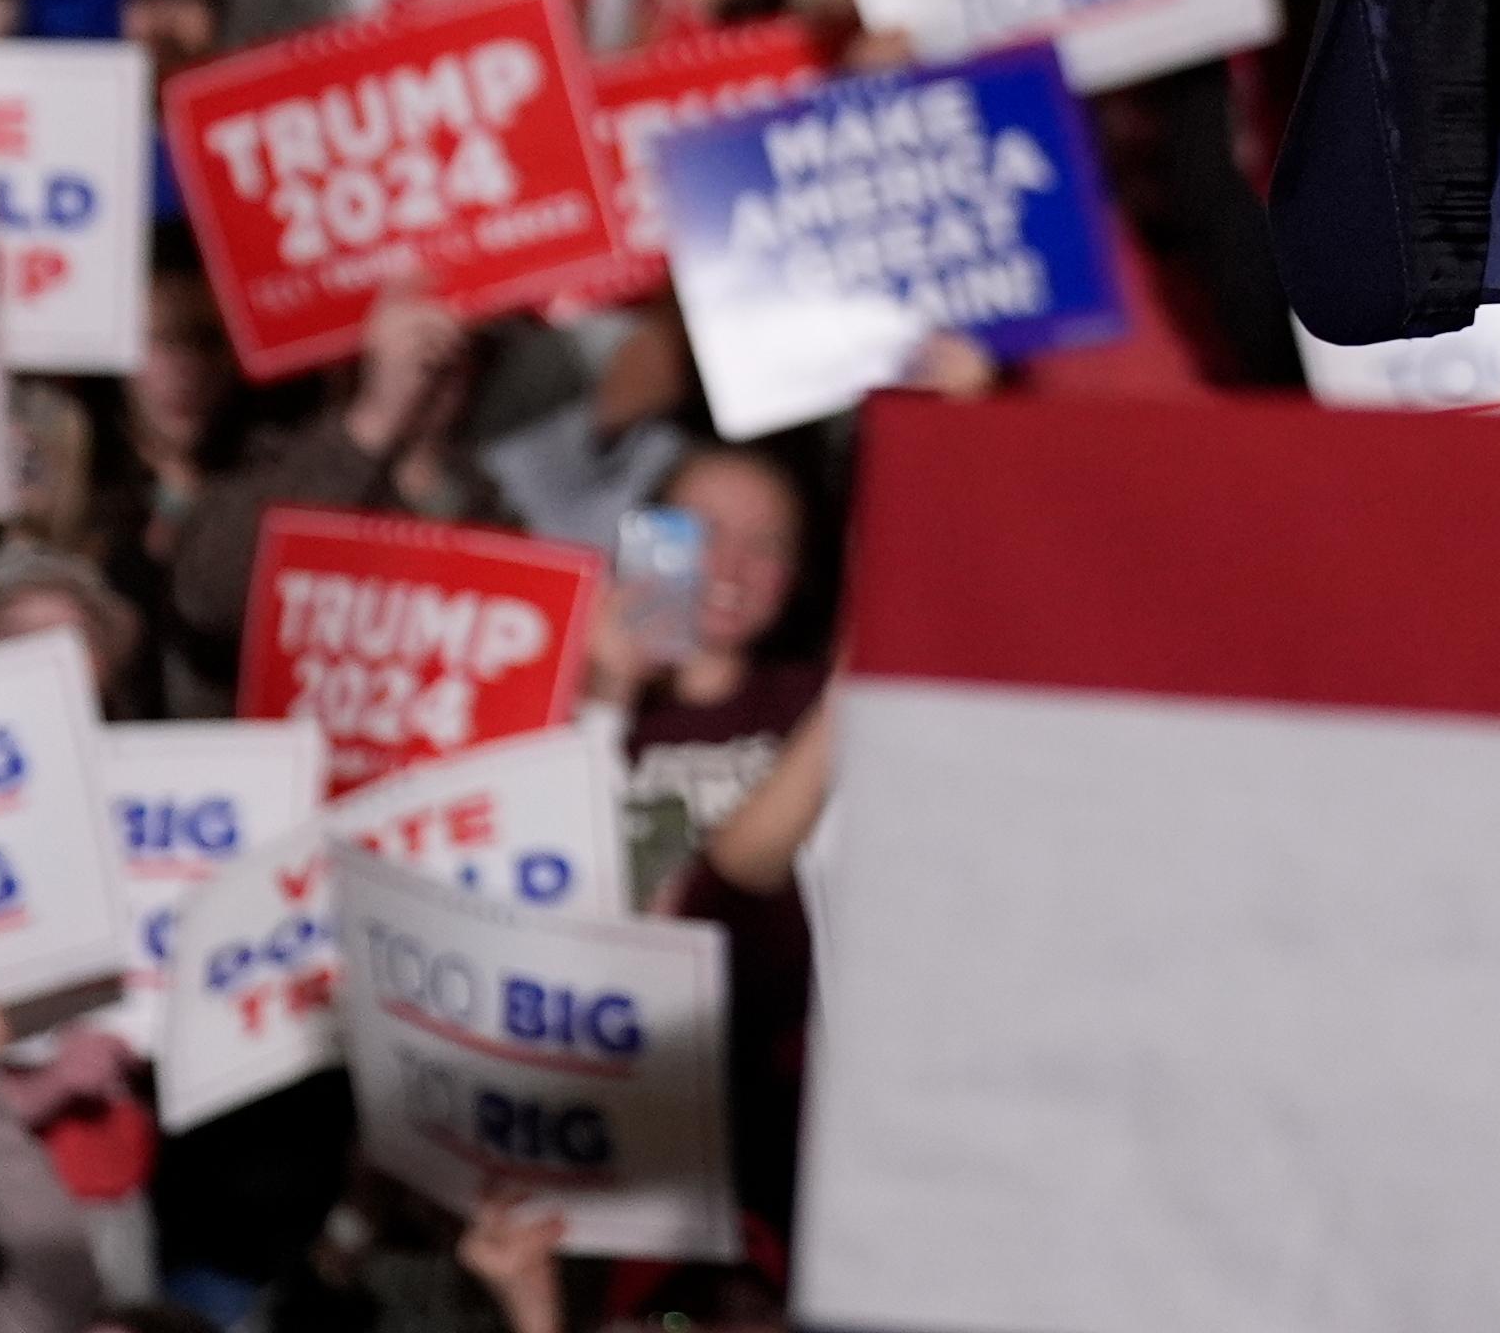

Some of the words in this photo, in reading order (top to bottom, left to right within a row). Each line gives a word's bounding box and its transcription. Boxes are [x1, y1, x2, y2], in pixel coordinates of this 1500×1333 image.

[204, 35, 542, 203] TRUMP
[762, 79, 977, 179] MAKE
[268, 129, 520, 267] 2024
[726, 127, 1055, 255] AMERICA
[902, 257, 1048, 325] AIN!
[276, 571, 552, 681] TRUMP
[286, 661, 474, 749] 2024
[364, 925, 476, 1021] TOO
[503, 977, 650, 1059] BIG
[474, 1087, 614, 1169] RIG
